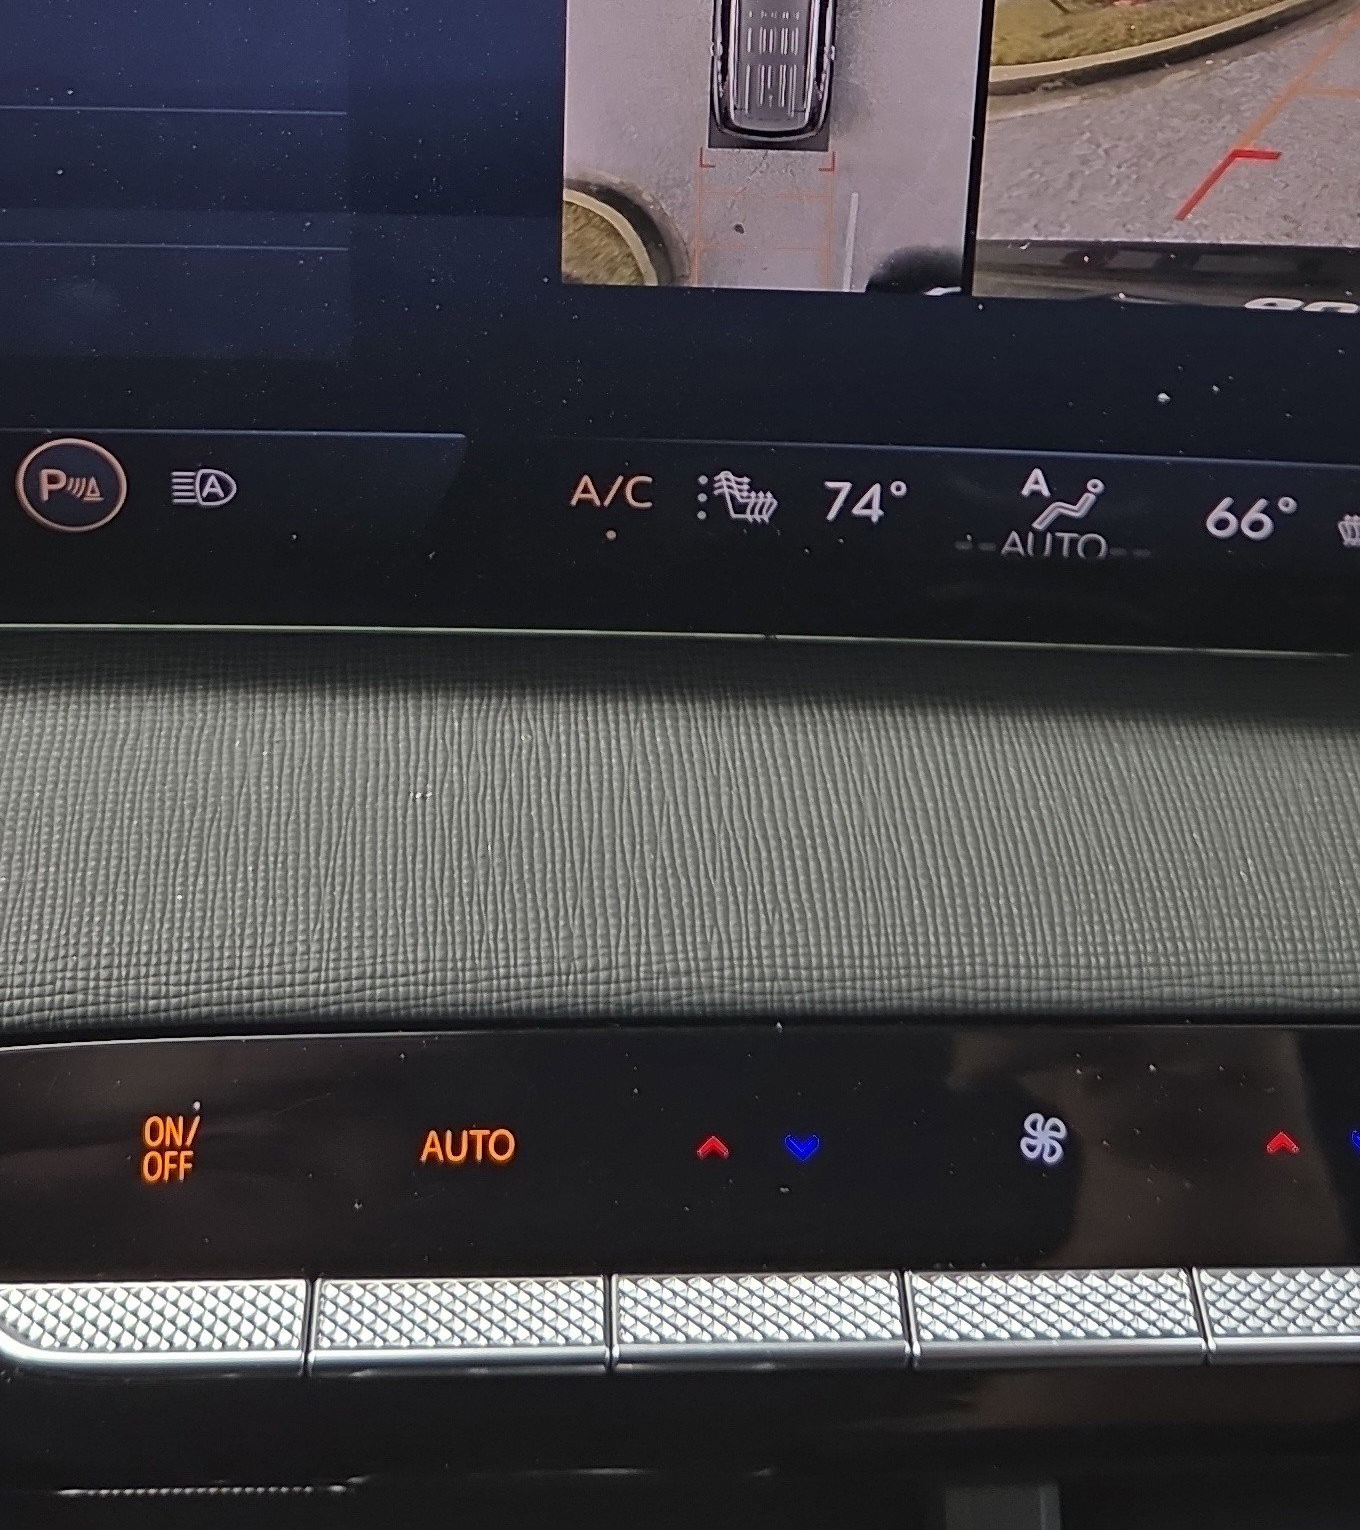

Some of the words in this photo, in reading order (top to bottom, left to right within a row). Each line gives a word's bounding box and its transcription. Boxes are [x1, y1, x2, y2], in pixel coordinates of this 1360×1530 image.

[570, 474, 653, 508] A/C
[823, 480, 908, 523] 74°
[1205, 496, 1298, 540] 66°
[1001, 530, 1108, 559] AUTO
[144, 1115, 201, 1148] ON/
[419, 1128, 516, 1163] AUTO
[142, 1149, 194, 1183] OFF
